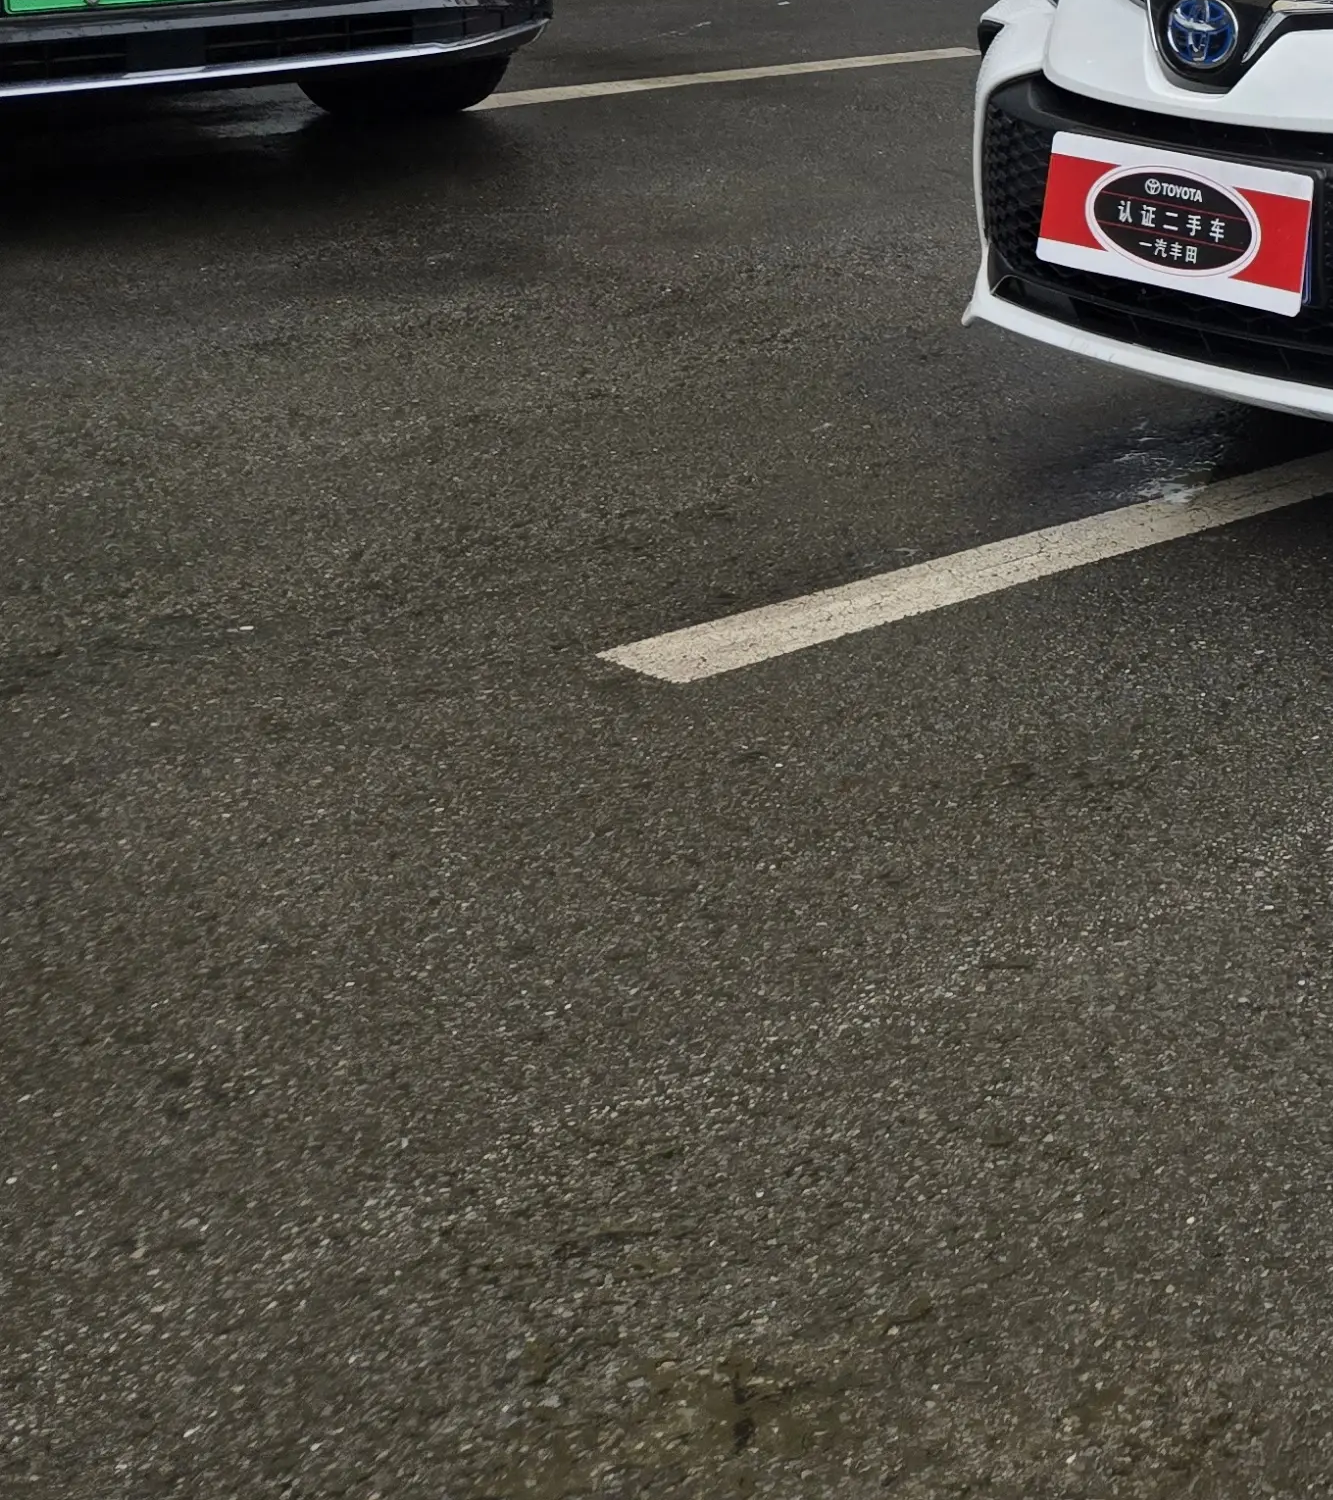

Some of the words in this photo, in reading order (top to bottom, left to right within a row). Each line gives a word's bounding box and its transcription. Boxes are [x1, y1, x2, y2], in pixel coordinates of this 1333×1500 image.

[1161, 182, 1203, 203] TOYOTA
[1117, 200, 1226, 243] 认证二手车
[1138, 238, 1198, 264] 一汽丰田
